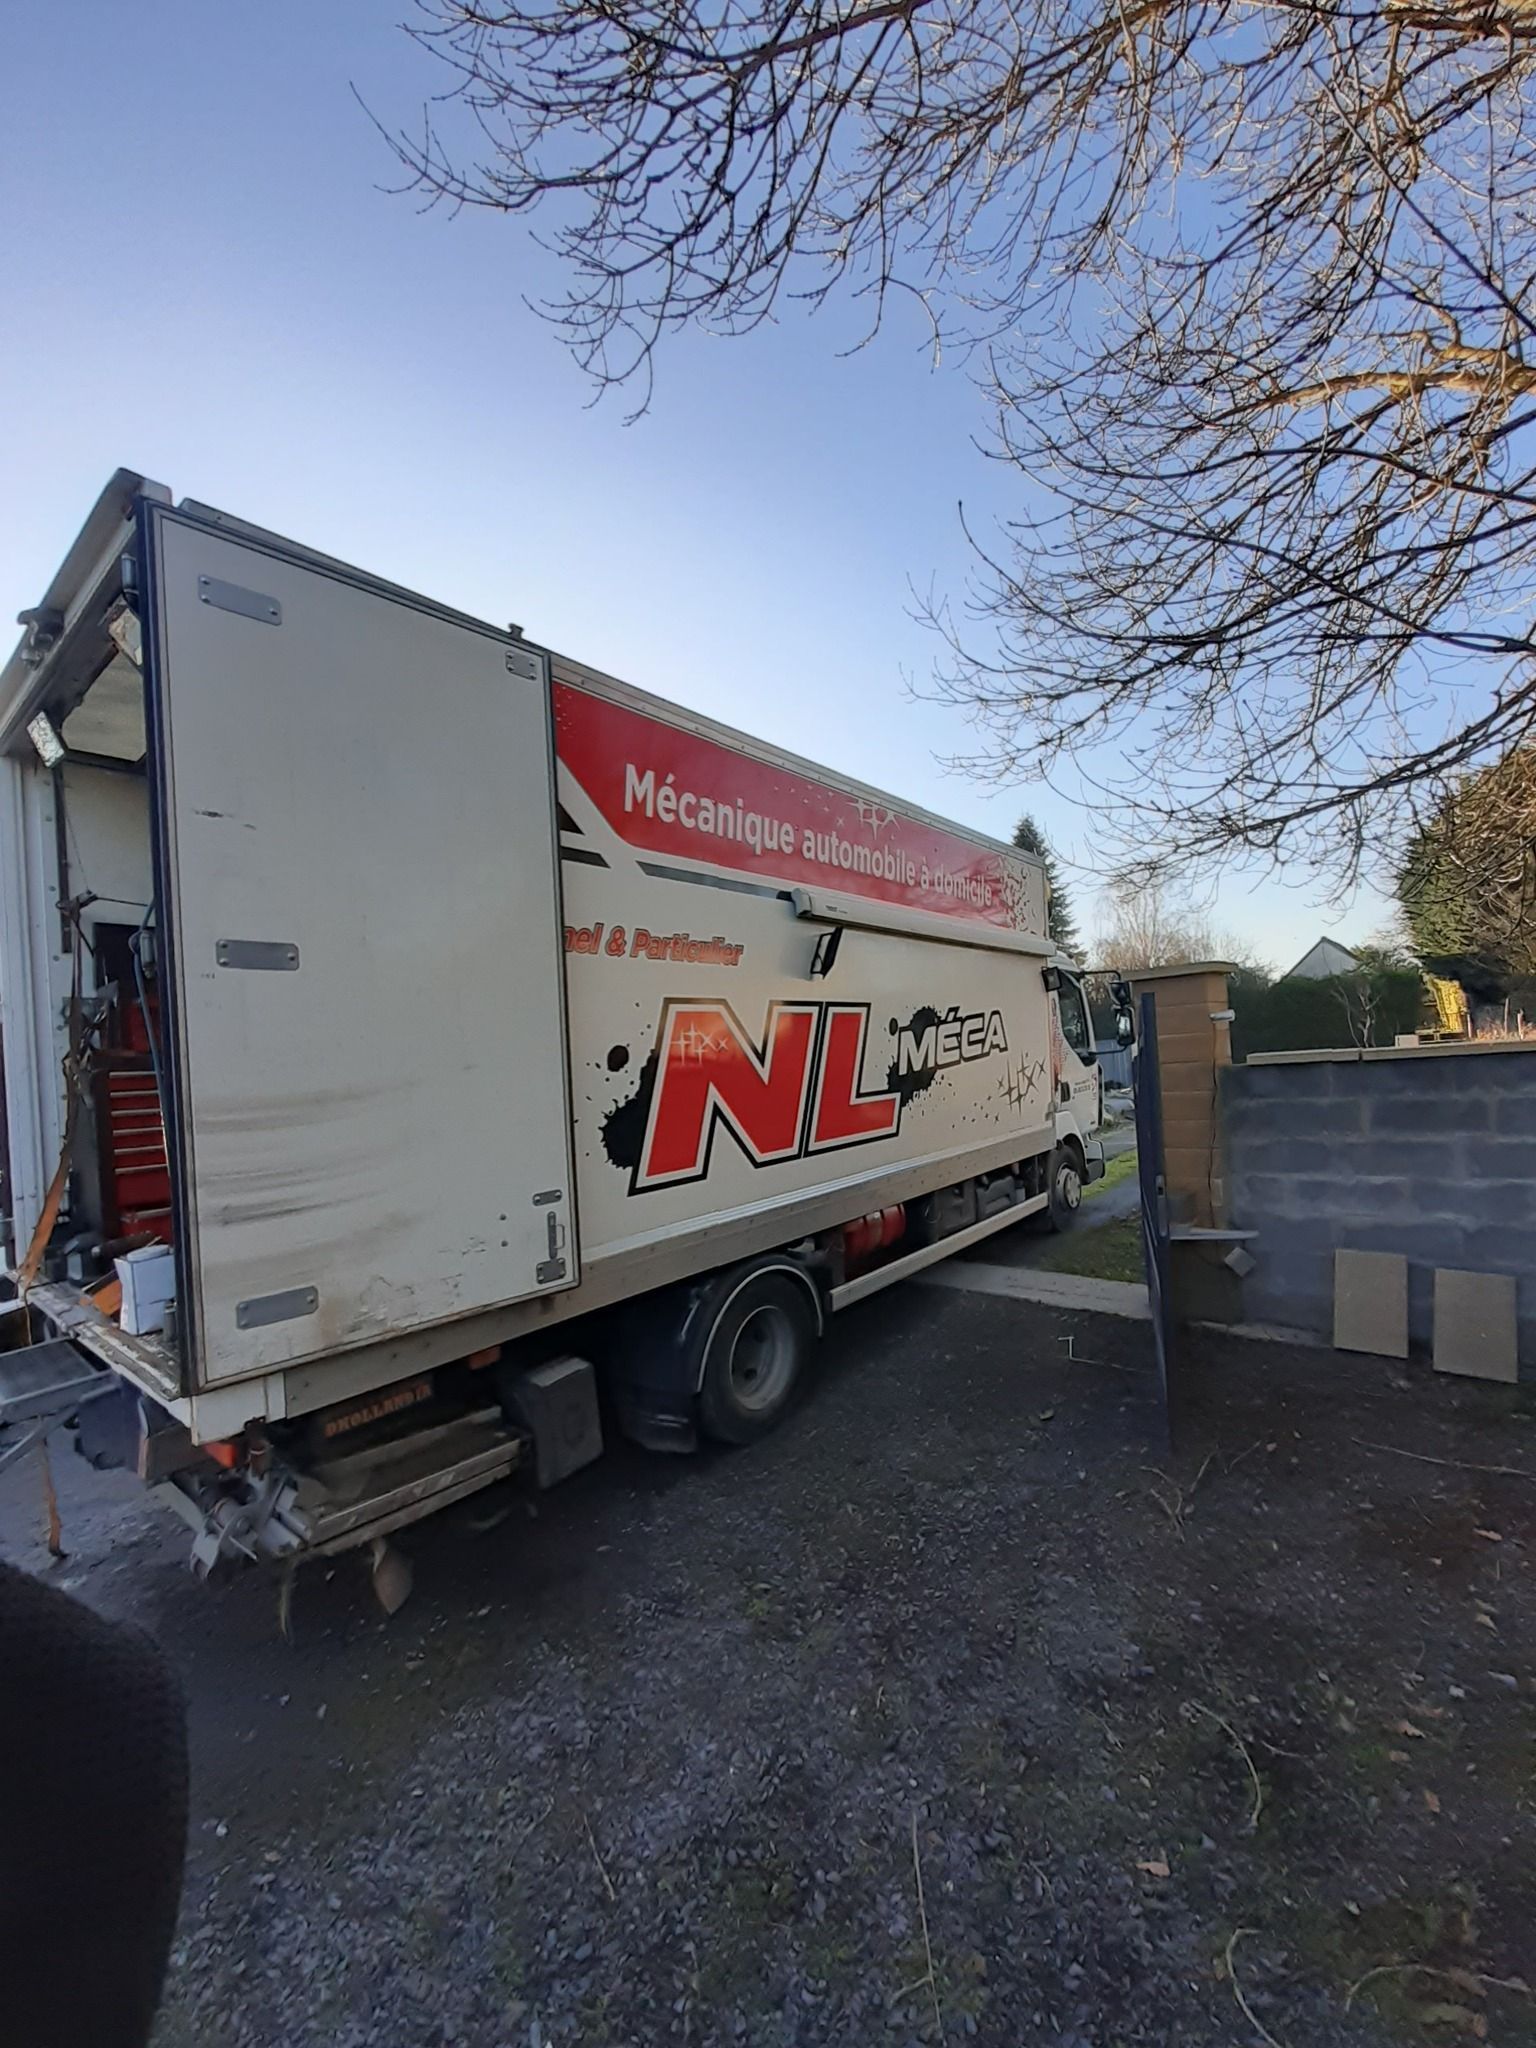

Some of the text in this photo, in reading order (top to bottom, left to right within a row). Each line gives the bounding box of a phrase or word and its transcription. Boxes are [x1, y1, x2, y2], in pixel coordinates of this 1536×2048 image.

[624, 763, 992, 908] Mécanique automobile à domicile
[606, 925, 627, 958] &
[630, 928, 744, 966] Particulier
[627, 997, 1008, 1197] NL MÉCA
